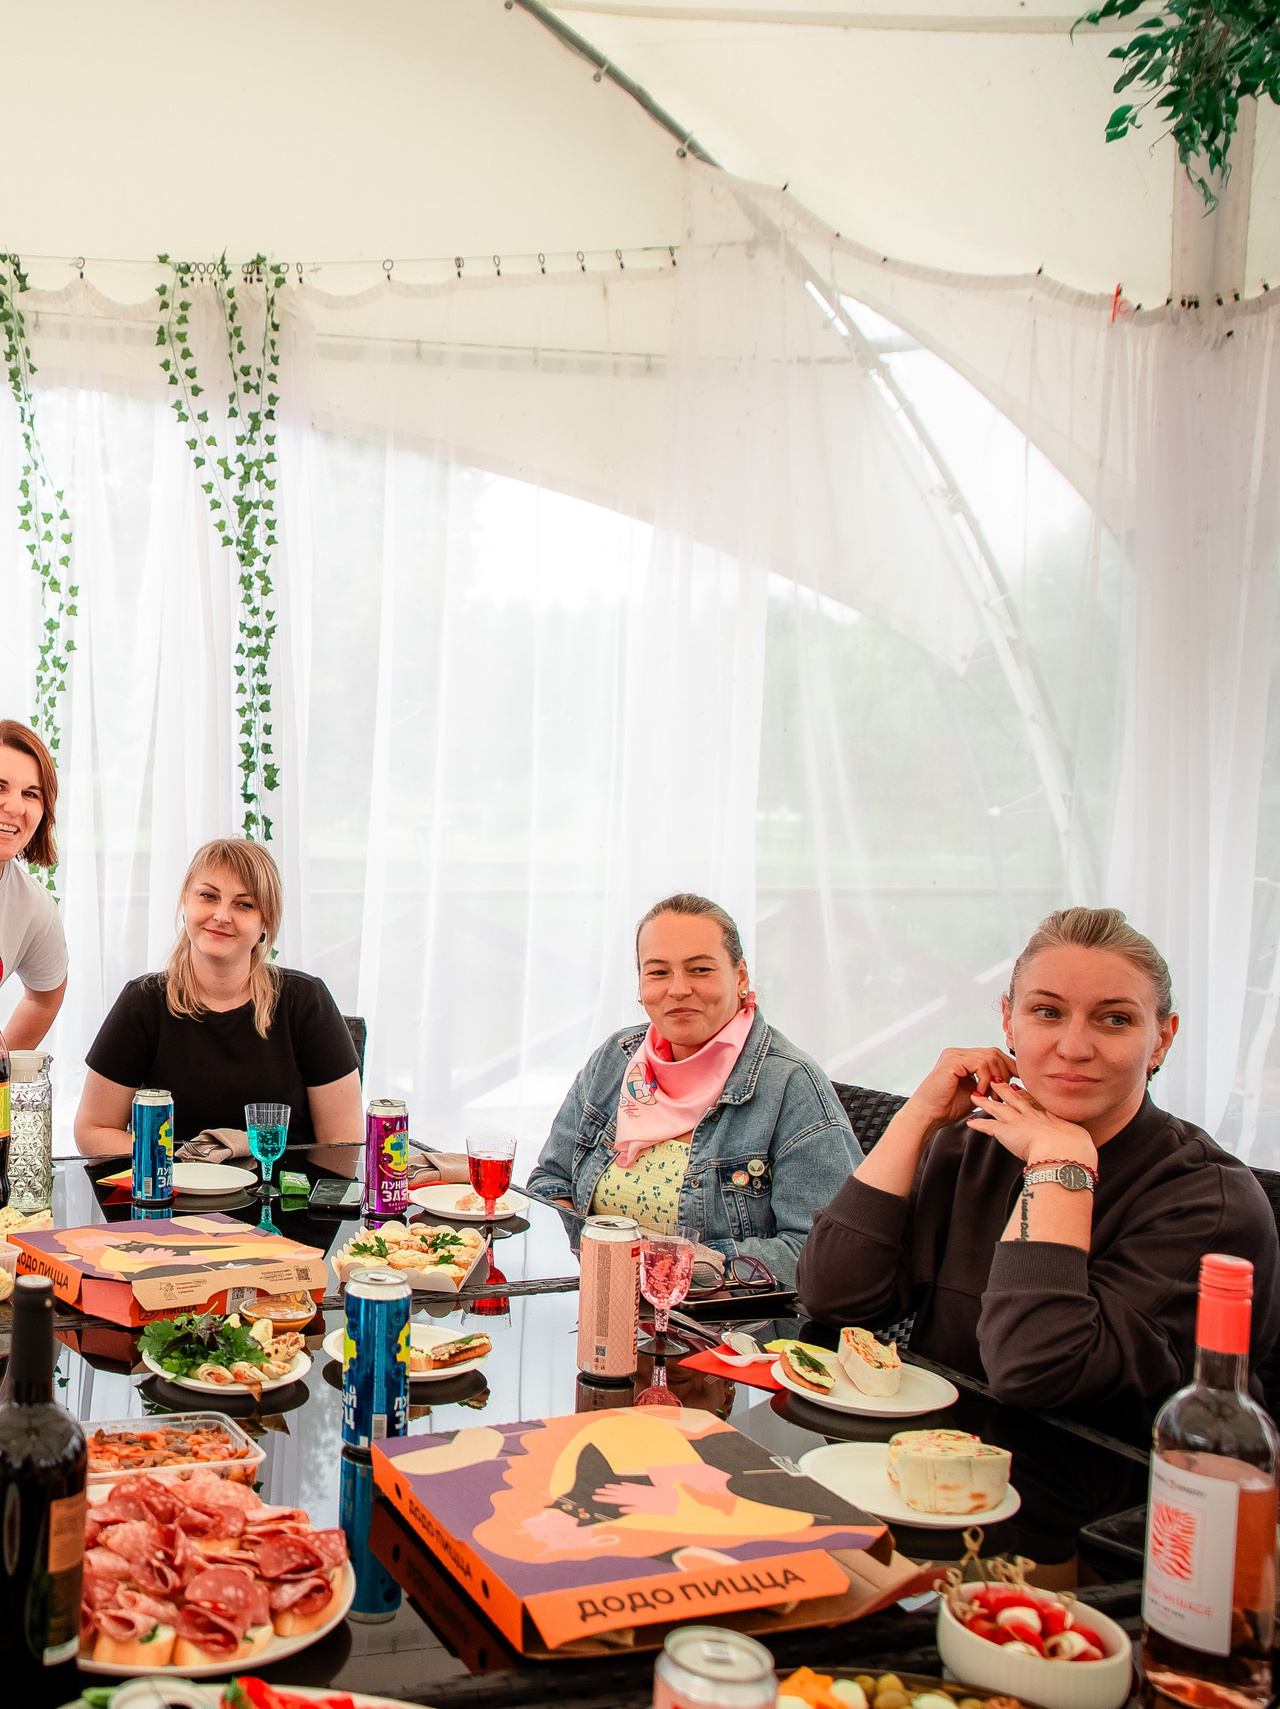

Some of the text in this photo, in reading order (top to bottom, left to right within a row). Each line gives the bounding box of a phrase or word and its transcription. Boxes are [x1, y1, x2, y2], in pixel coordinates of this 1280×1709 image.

[38, 1261, 69, 1290] ПИЦЦА
[409, 1499, 434, 1537] ДОДО
[435, 1529, 473, 1580] ПИЦЦА
[577, 1568, 806, 1622] ДОДО ПИЦЦА
